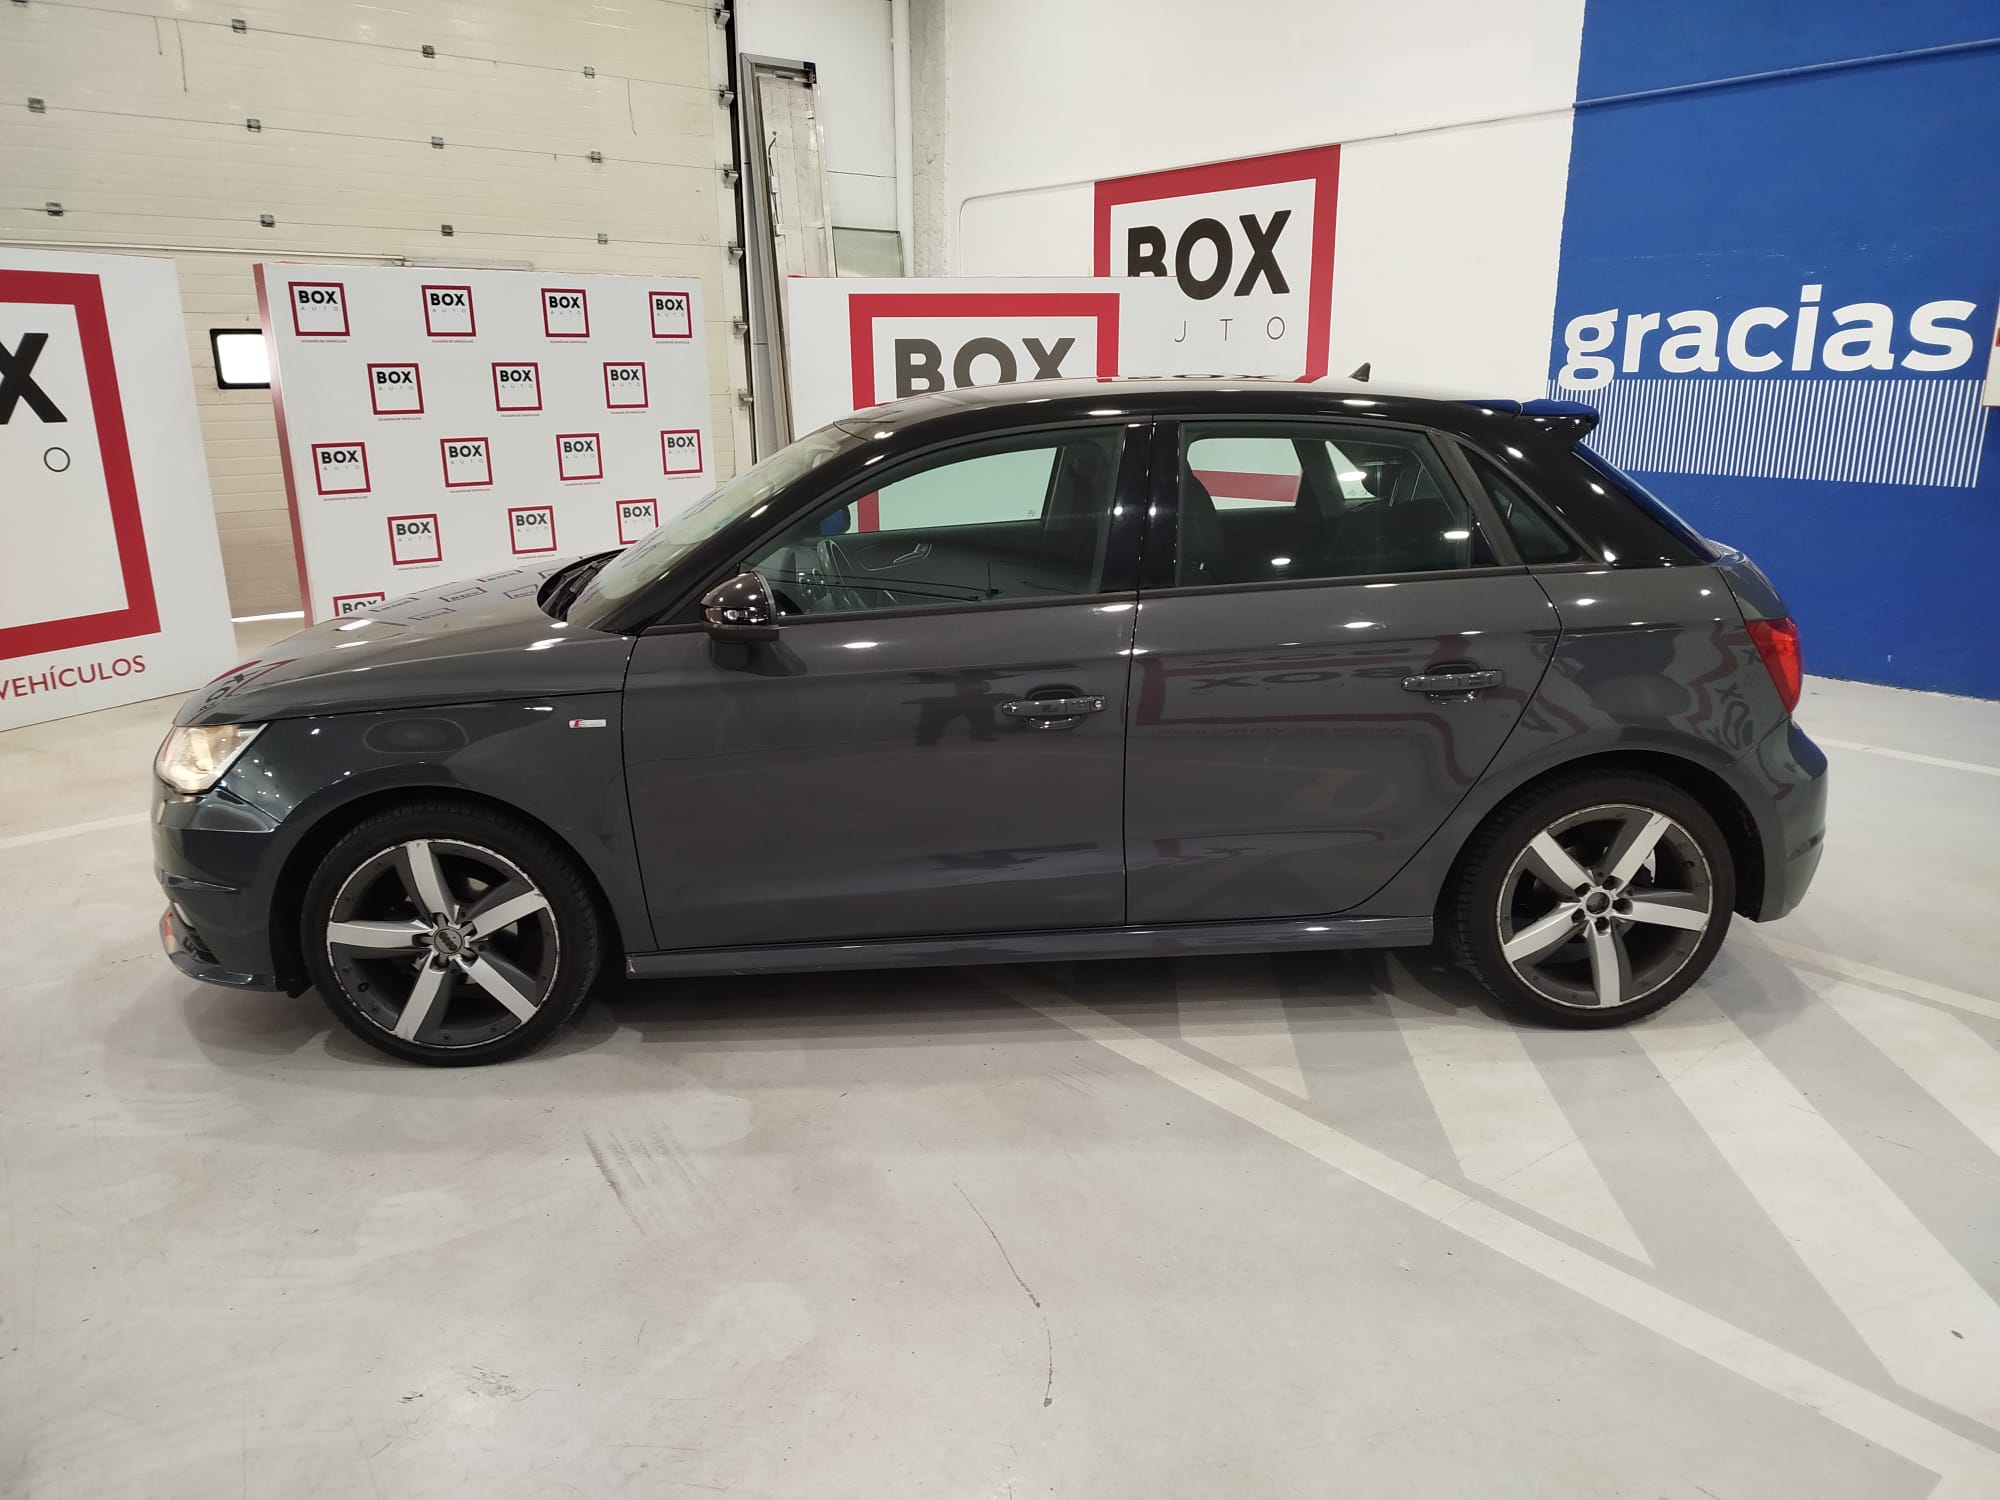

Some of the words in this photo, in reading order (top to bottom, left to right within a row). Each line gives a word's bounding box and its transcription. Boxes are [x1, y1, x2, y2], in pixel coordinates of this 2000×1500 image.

[1128, 210, 1291, 300] BOX
[298, 290, 338, 304] BOX
[430, 293, 465, 306] BOX
[549, 296, 581, 309] BOX
[656, 299, 684, 311] BOX
[1558, 284, 1977, 391] gracias
[894, 337, 1076, 399] BOX
[376, 371, 413, 384] BOX
[500, 370, 532, 382] BOX
[610, 369, 640, 381] BOX
[563, 440, 594, 453] BOX
[667, 436, 695, 448] BOX
[321, 450, 359, 464] BOX
[448, 445, 482, 458] BOX
[623, 506, 651, 518] BOX
[515, 513, 547, 526] BOX
[396, 522, 432, 535] BOX
